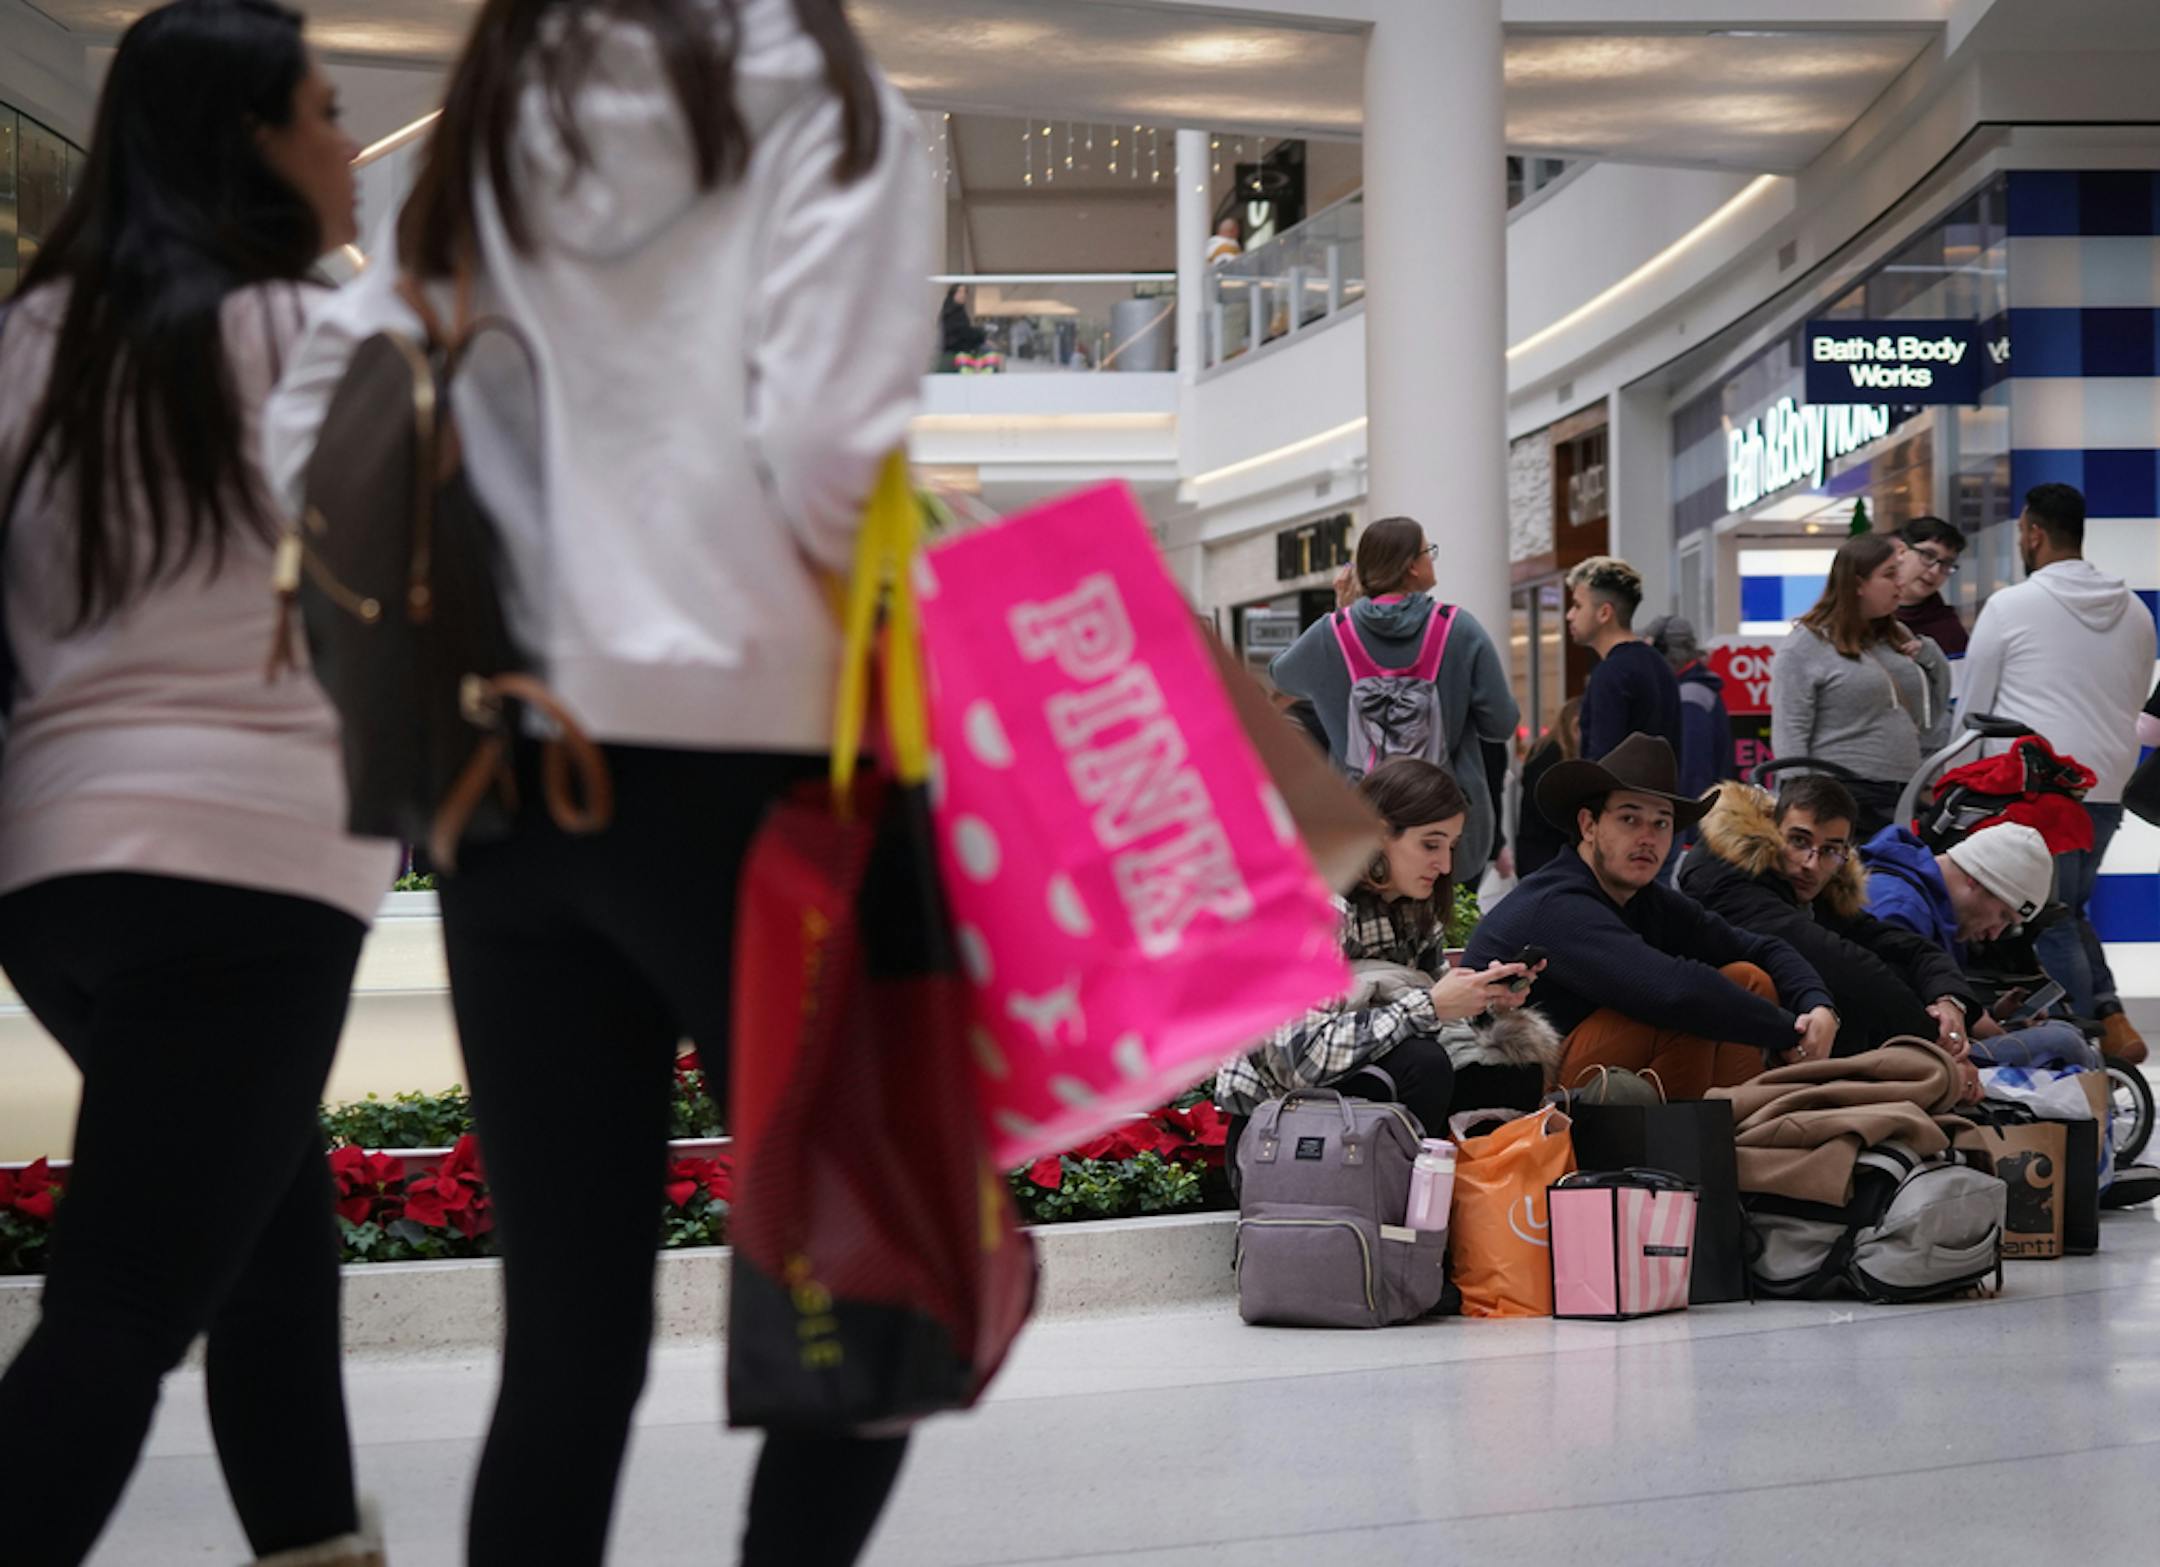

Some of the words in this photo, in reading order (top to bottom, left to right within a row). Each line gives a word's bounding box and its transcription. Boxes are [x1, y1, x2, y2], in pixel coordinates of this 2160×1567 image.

[1849, 364, 1933, 387] Works
[1729, 655, 1775, 680] ON
[1005, 570, 1255, 959] PINK
[2001, 1239, 2055, 1255] artt
